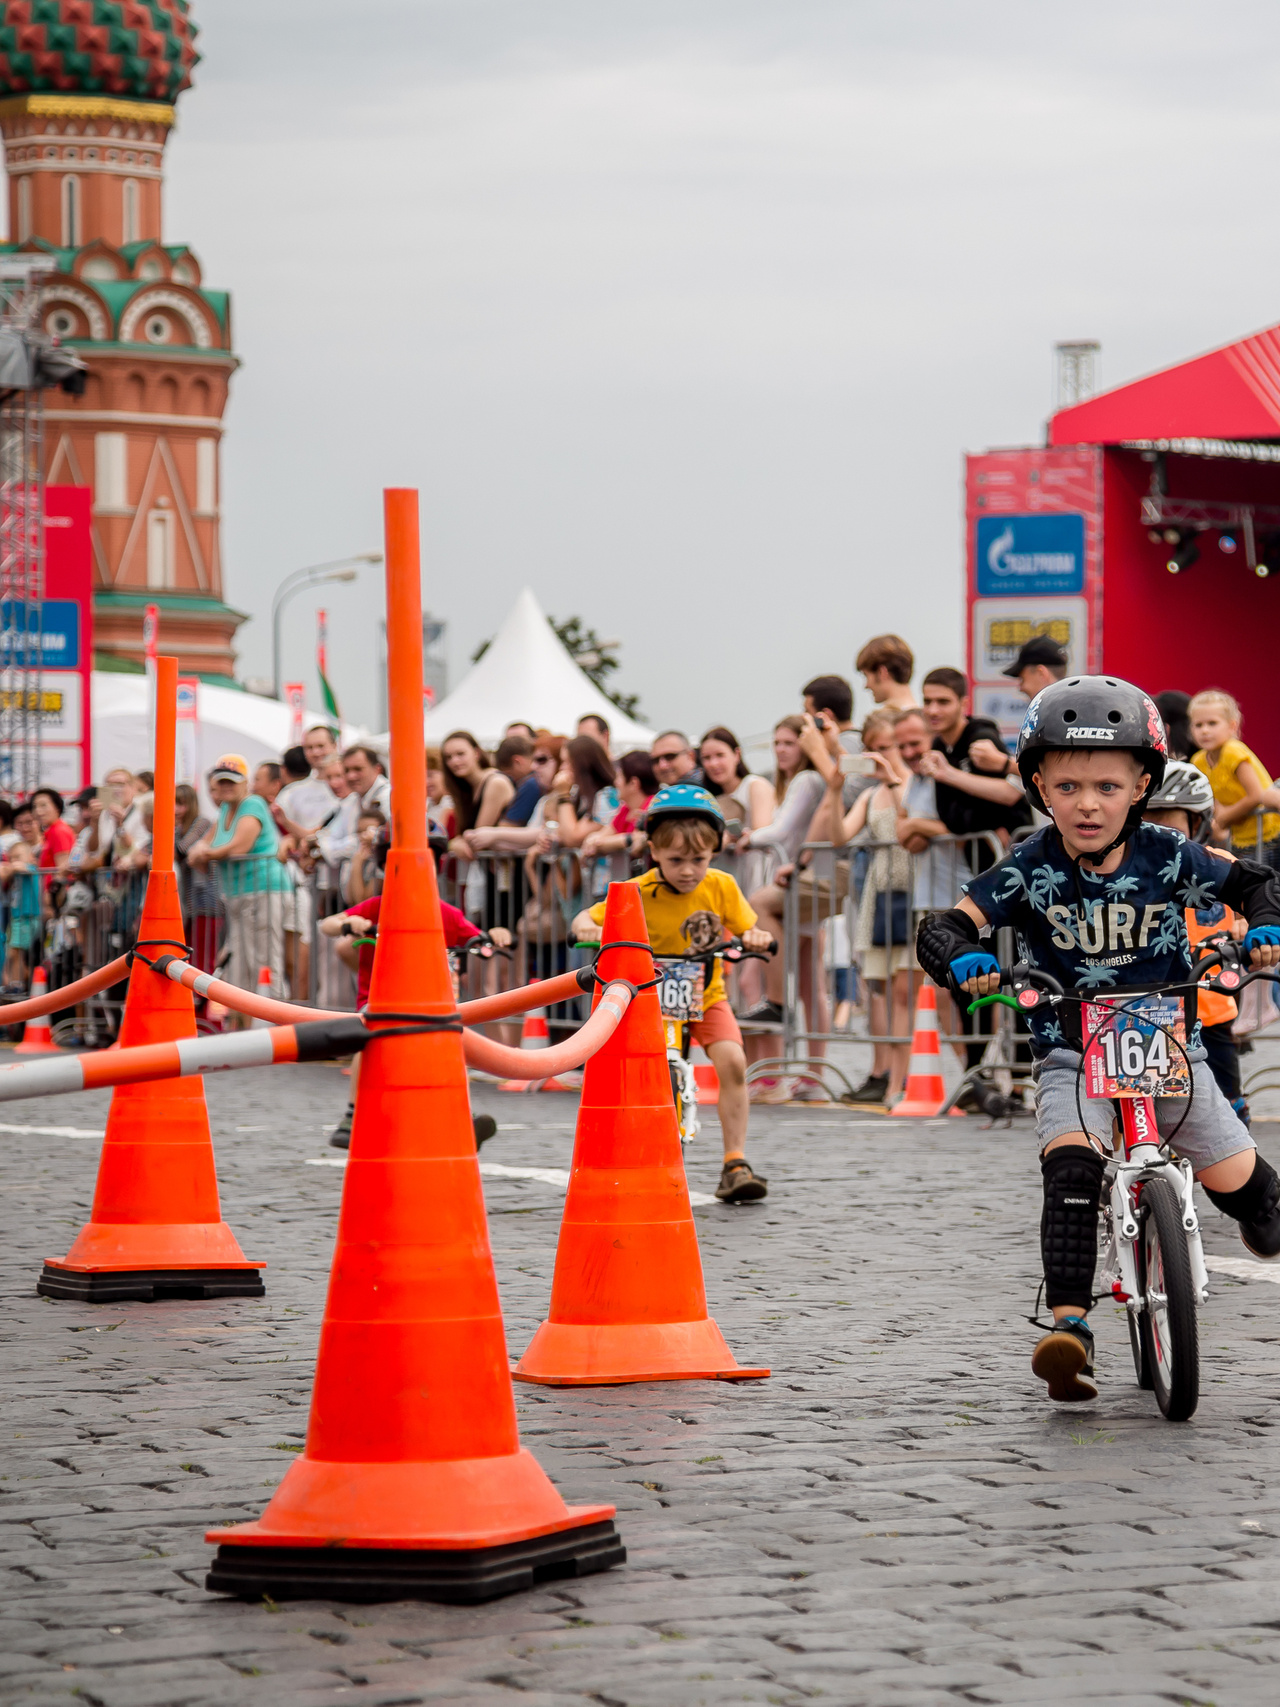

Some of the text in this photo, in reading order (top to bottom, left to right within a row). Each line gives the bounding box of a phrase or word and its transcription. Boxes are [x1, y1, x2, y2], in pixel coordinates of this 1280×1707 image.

[1066, 727, 1115, 740] ROCES
[1046, 903, 1167, 954] SURF
[1101, 1030, 1170, 1076] 164
[1133, 1097, 1148, 1141] woom
